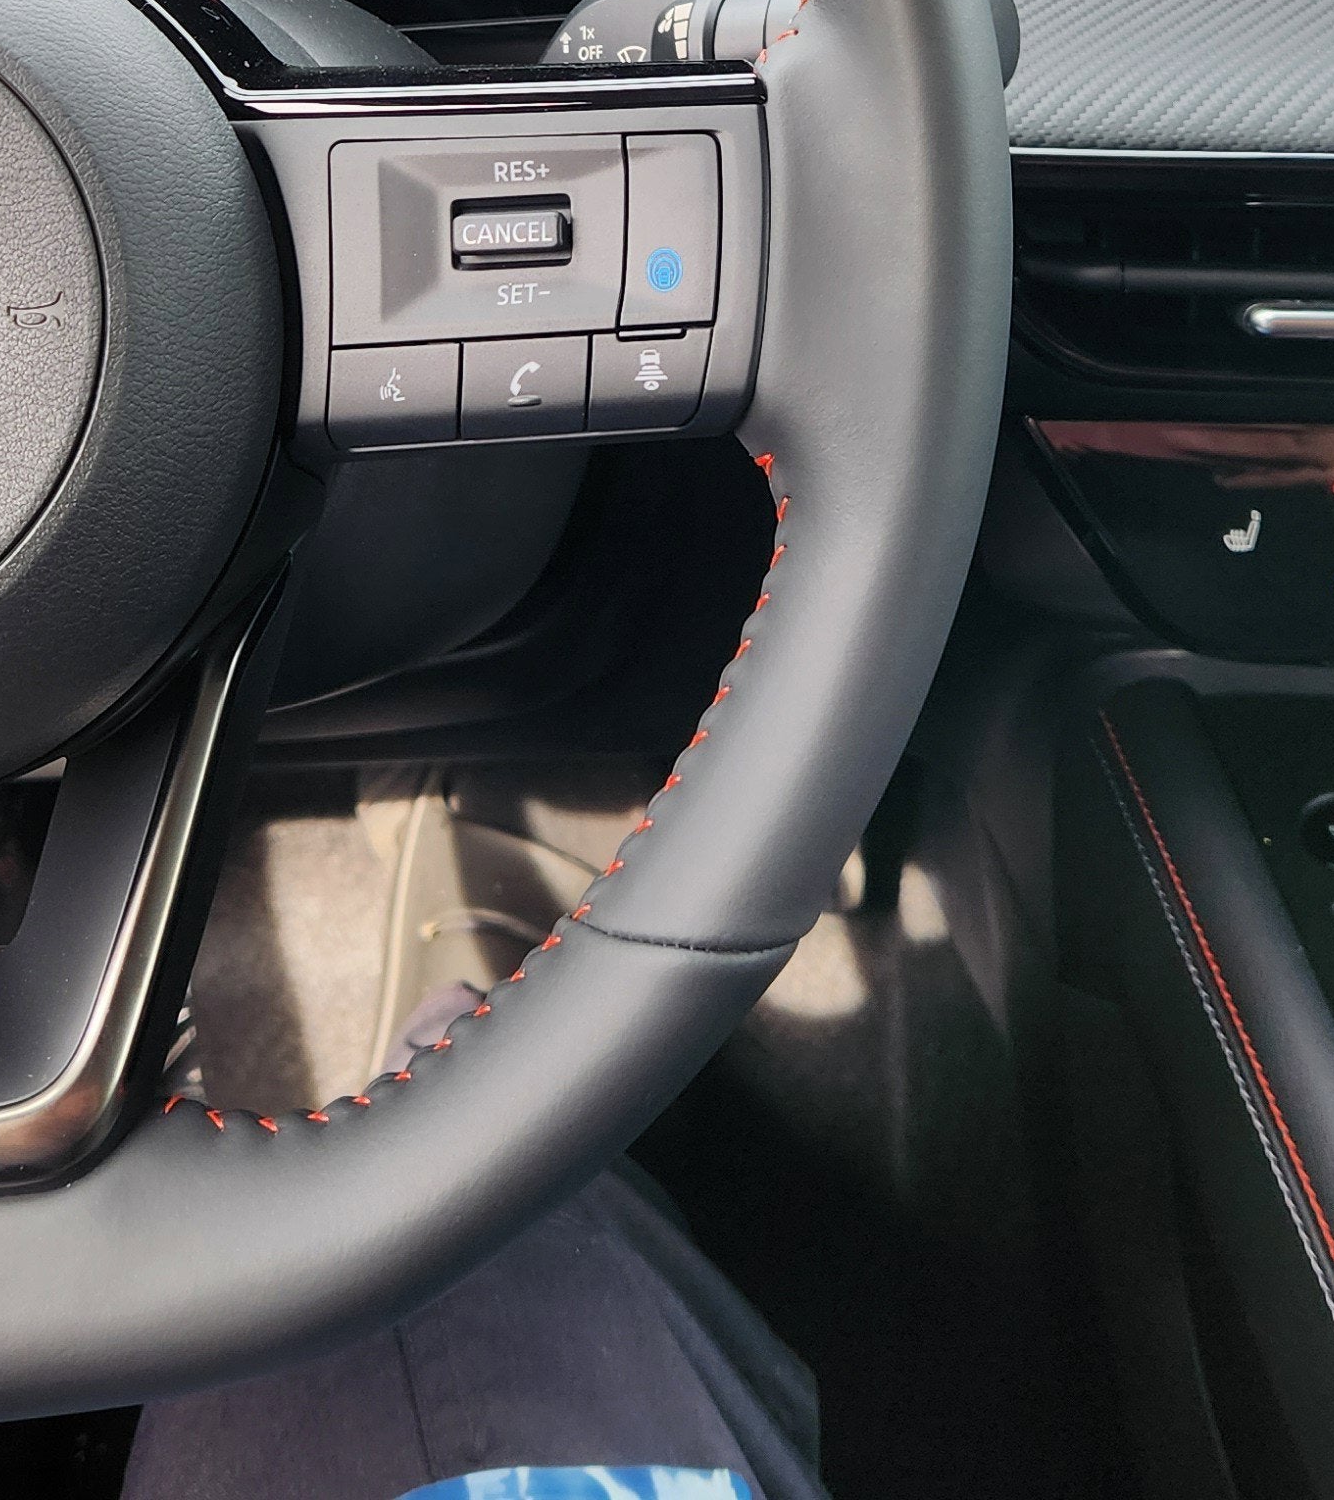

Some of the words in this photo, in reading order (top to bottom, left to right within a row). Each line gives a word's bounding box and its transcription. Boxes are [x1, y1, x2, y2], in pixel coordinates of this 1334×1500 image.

[578, 25, 596, 41] 1x
[577, 44, 604, 61] OFF
[493, 160, 551, 183] RES+
[462, 220, 553, 245] CANCEL
[496, 282, 552, 306] SET-
